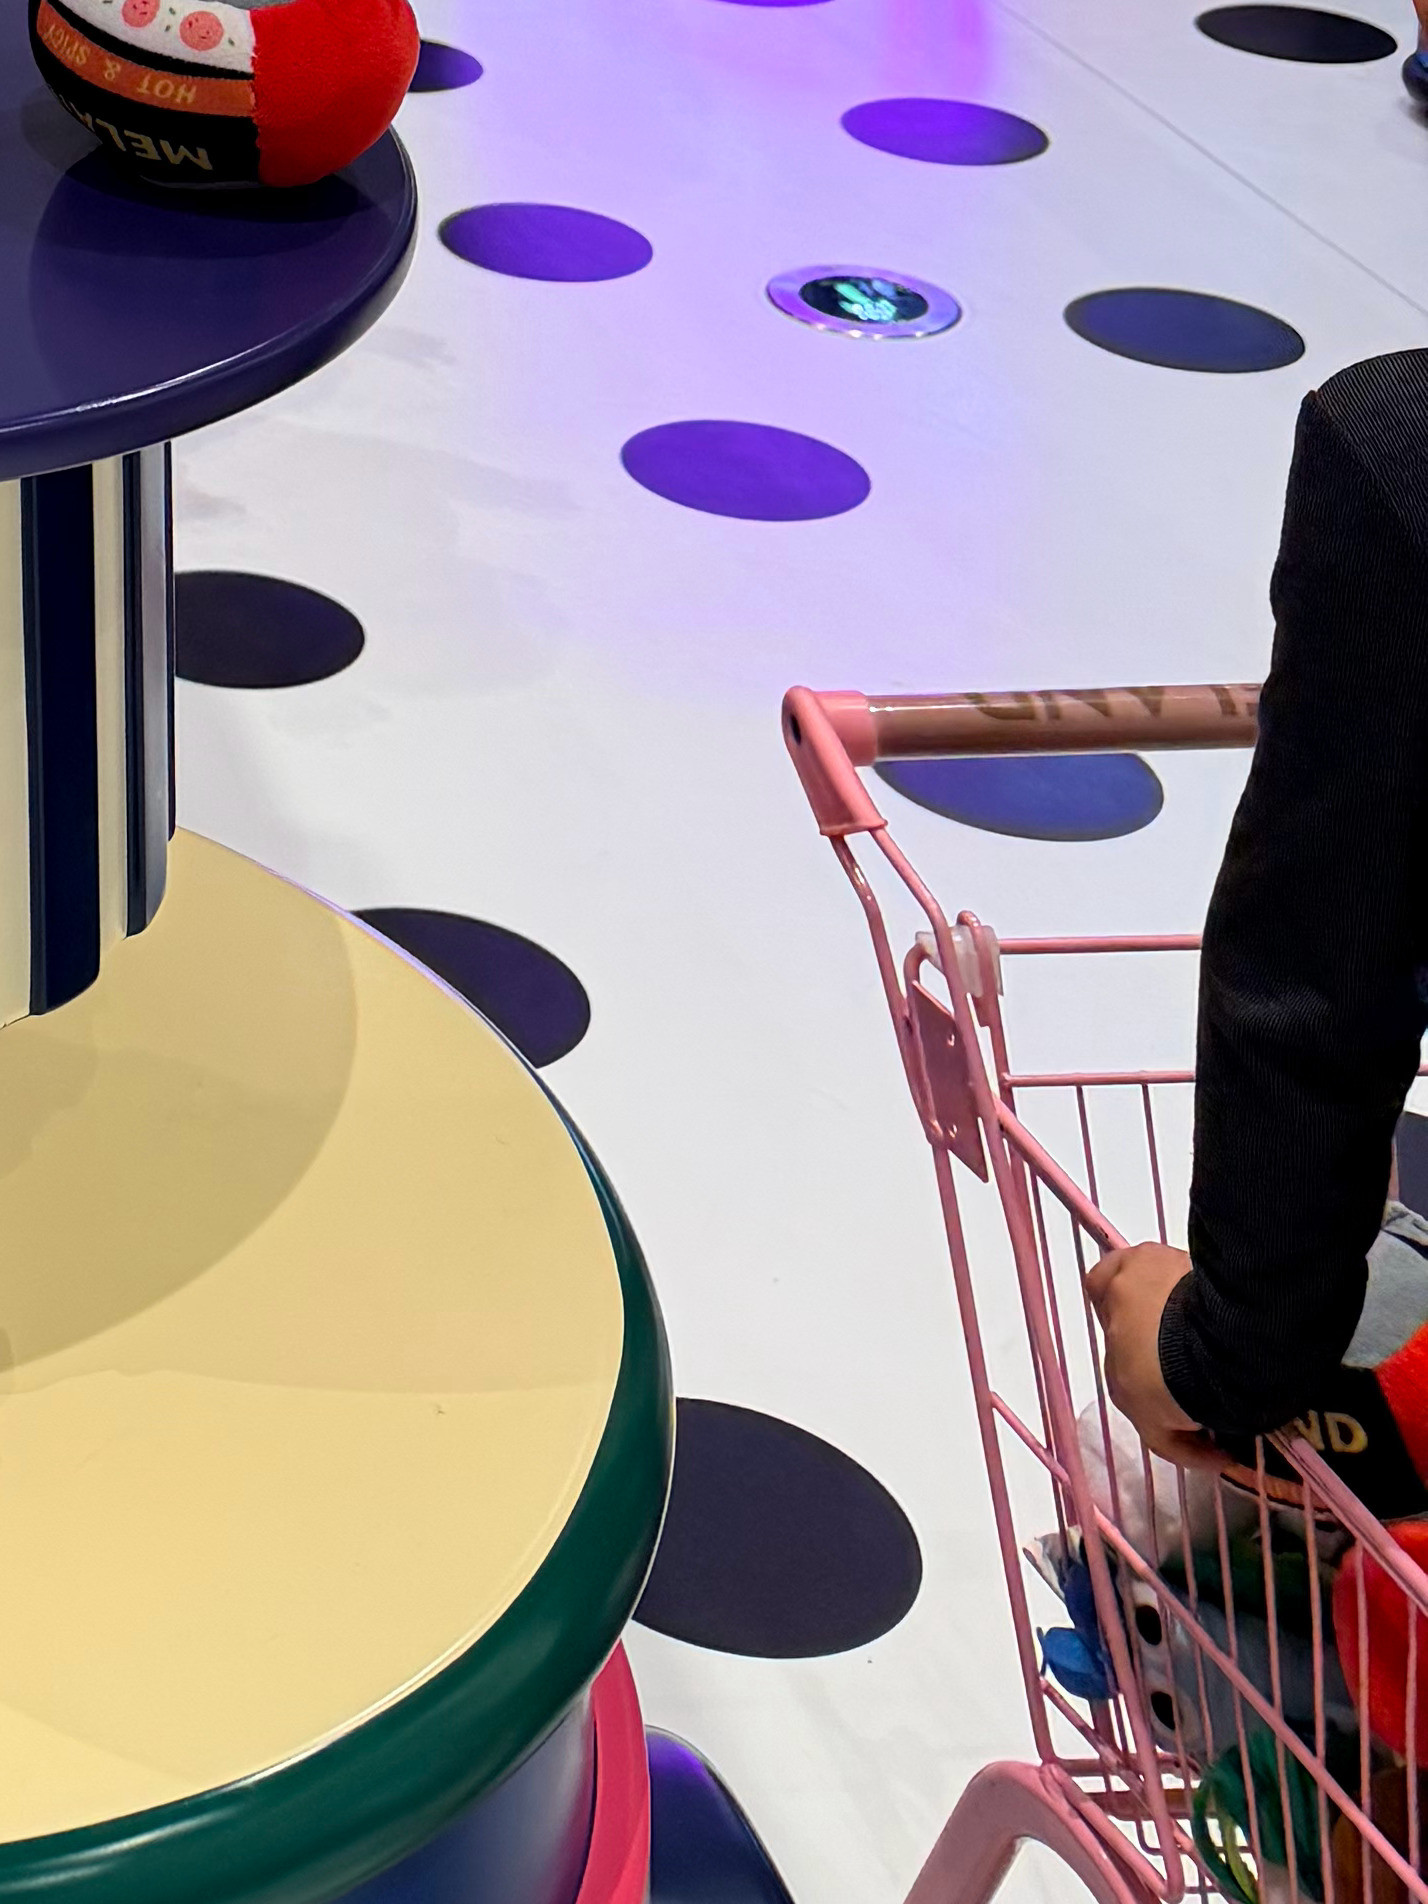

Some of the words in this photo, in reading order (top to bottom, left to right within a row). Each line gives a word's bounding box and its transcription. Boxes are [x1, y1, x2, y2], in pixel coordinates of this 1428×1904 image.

[43, 23, 90, 67] SPICY
[103, 61, 122, 81] &
[136, 77, 197, 104] HOT
